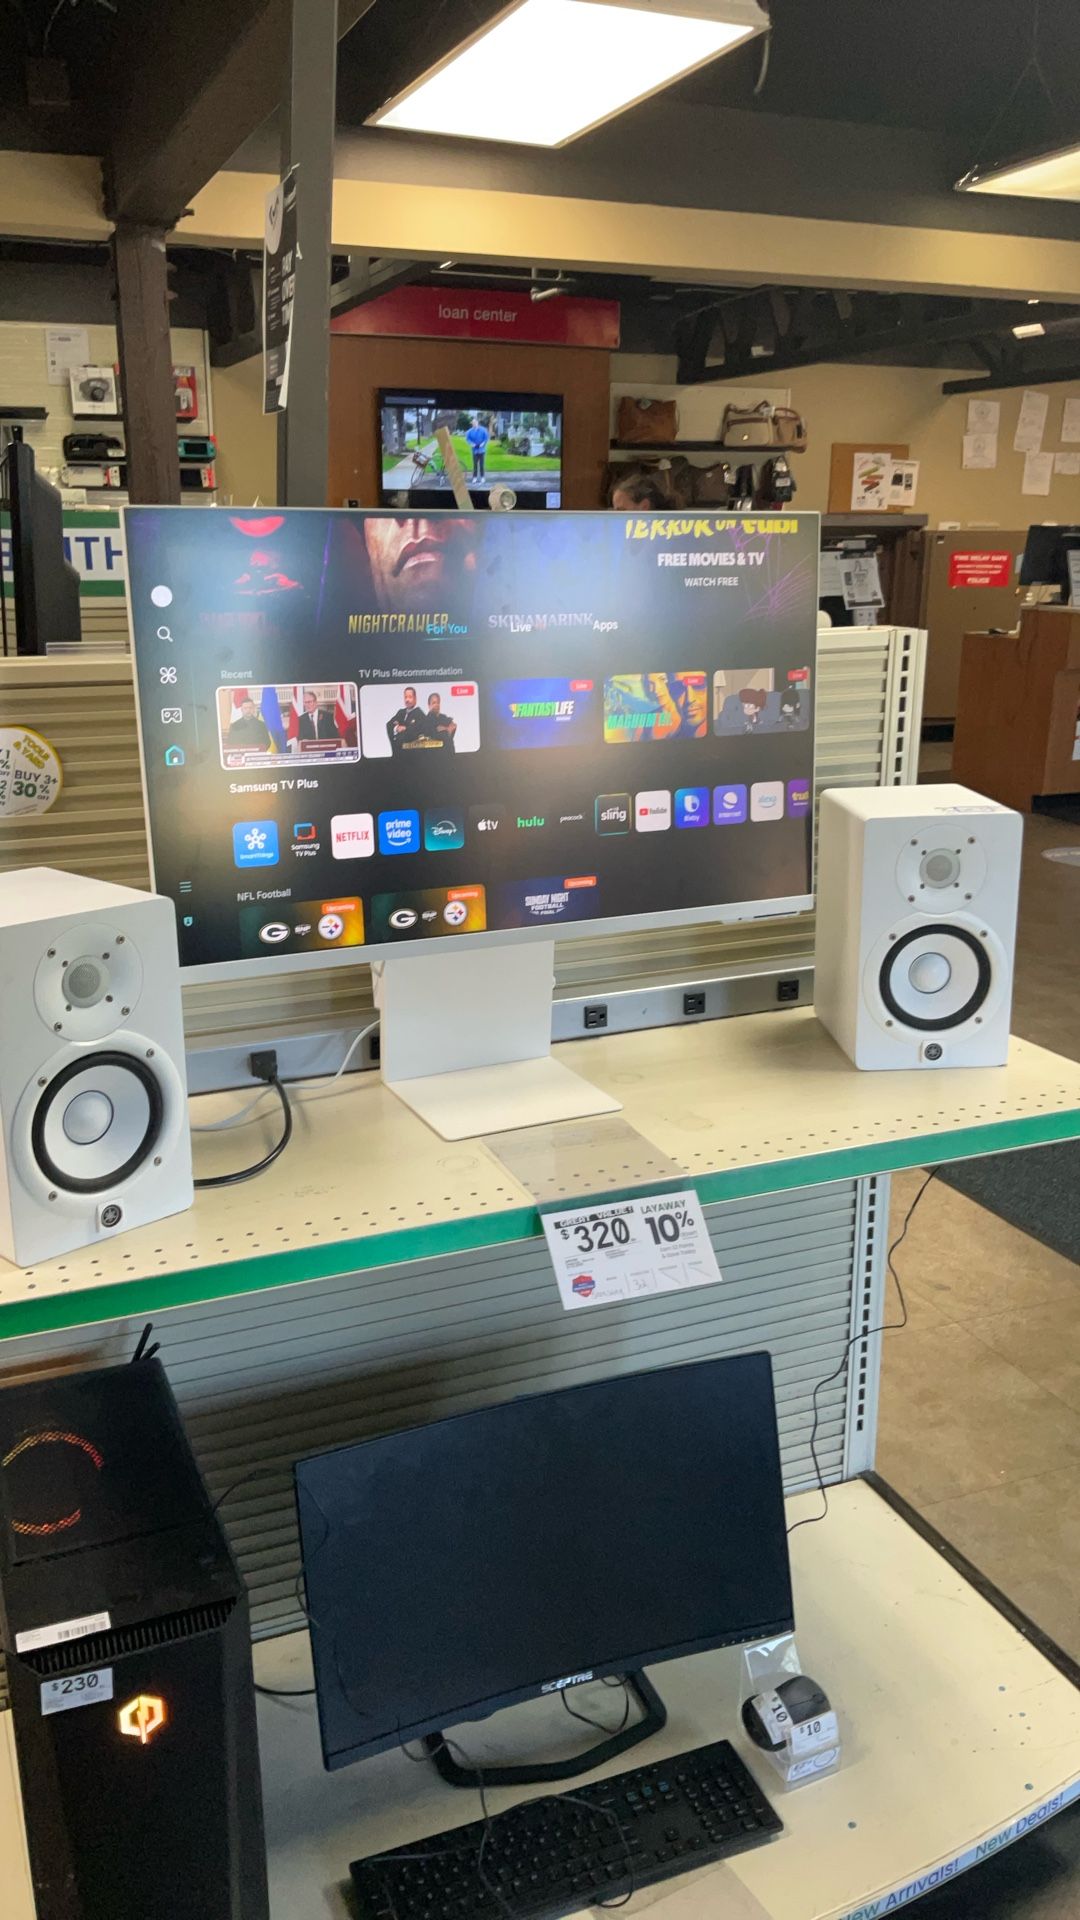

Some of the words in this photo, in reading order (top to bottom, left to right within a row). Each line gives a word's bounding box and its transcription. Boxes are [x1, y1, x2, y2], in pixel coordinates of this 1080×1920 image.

[438, 304, 469, 319] loan
[473, 308, 518, 322] center
[657, 553, 687, 567] FREE
[689, 552, 736, 566] MOVIES
[737, 552, 747, 566] &
[747, 552, 765, 566] TV
[684, 577, 716, 587] WATCH
[717, 577, 739, 586] FREE
[427, 624, 445, 635] For
[447, 623, 468, 634] You
[510, 622, 532, 633] Live
[592, 620, 619, 633] Apps
[220, 670, 253, 680] Recent
[359, 669, 371, 679] TV
[372, 669, 390, 679] Plus
[391, 667, 463, 678] Recommendation
[14, 769, 41, 783] BUY
[43, 774, 58, 785] 3+
[12, 781, 37, 798] 30
[229, 782, 278, 794] Samsung
[280, 780, 295, 790] TV
[297, 778, 319, 789] Plus
[517, 816, 545, 829] hulu
[601, 810, 627, 822] sling
[386, 819, 412, 831] prime
[487, 820, 499, 831] tv
[336, 831, 370, 843] NETFLIX
[386, 829, 412, 840] video
[290, 843, 320, 851] Samsung
[236, 892, 255, 902] NFL
[256, 888, 292, 900] Football
[640, 1199, 686, 1214] LAYAWAY
[560, 1214, 591, 1228] GREAT
[645, 1210, 695, 1245] 10%
[560, 1217, 630, 1252] $320
[51, 1673, 99, 1694] $230
[541, 1670, 593, 1694] SCEPTRE
[771, 1696, 788, 1723] $10
[799, 1721, 821, 1736] $10
[885, 1859, 960, 1910] Arrivals!
[975, 1827, 1013, 1858] New
[1015, 1792, 1064, 1834] Deals!
